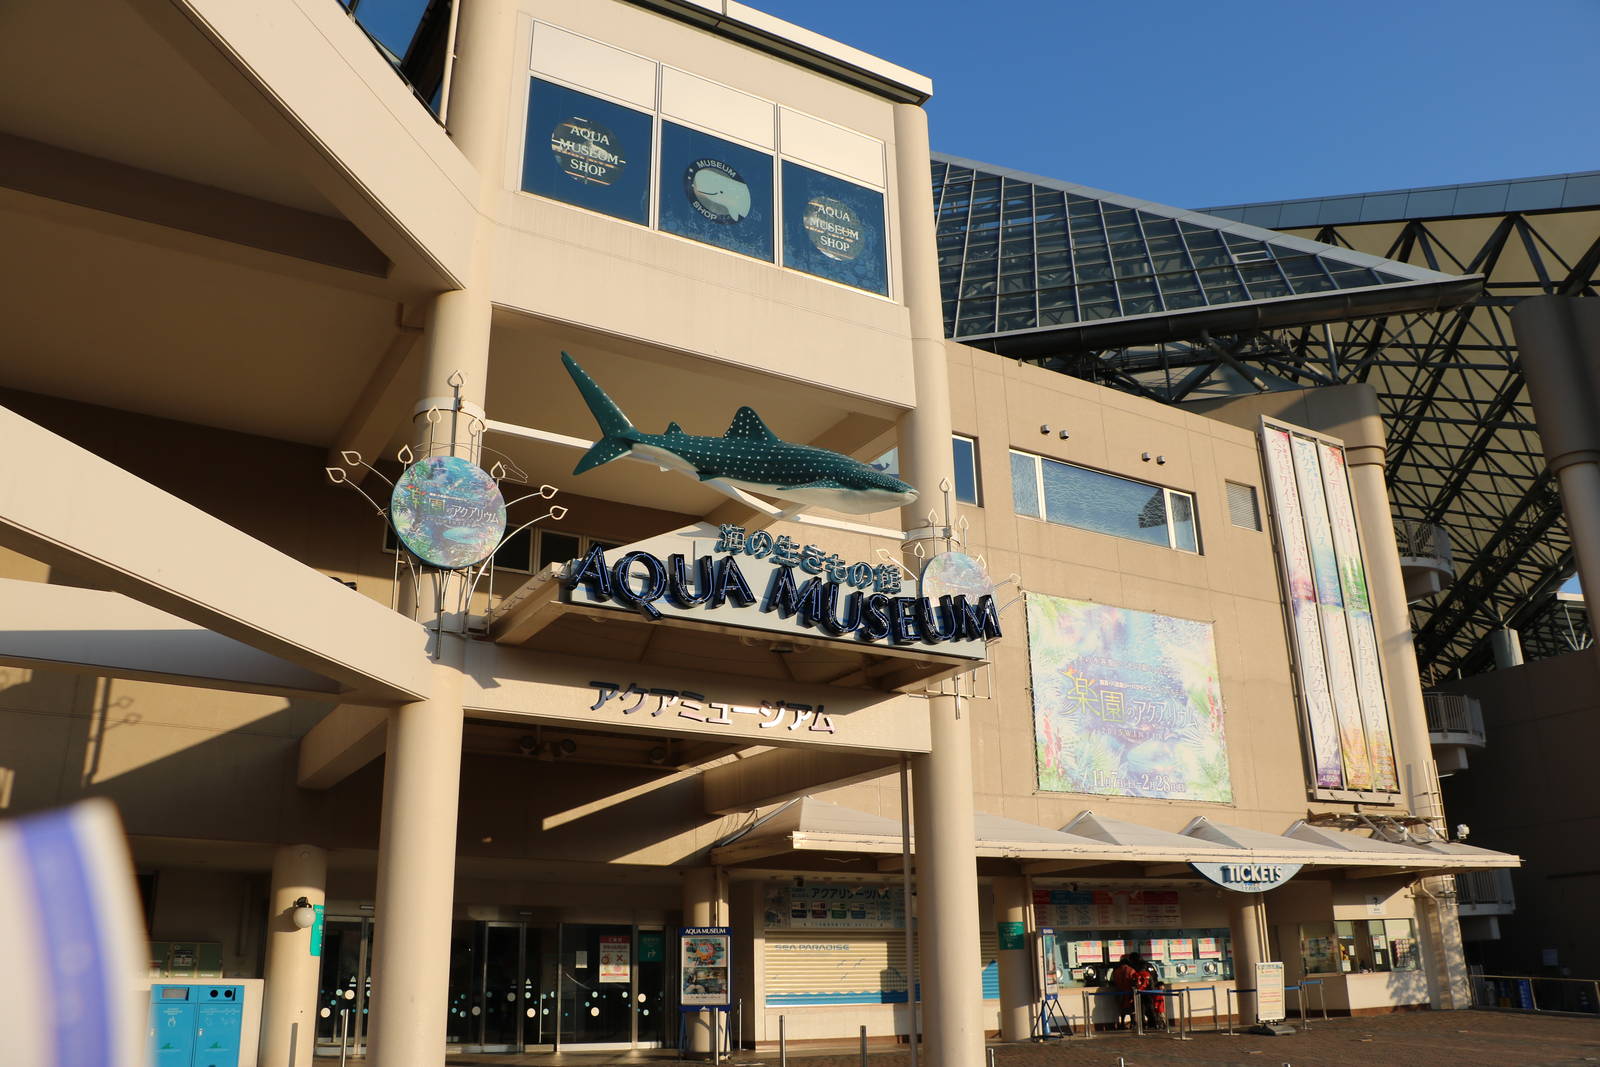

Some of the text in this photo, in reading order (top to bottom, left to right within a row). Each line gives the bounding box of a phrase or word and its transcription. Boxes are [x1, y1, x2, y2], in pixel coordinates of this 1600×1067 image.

[570, 126, 610, 146] AQUA
[559, 138, 619, 165] MUSEUM
[570, 158, 606, 176] SHOP
[696, 159, 737, 178] MUSEUM
[692, 200, 718, 220] SHOP
[817, 205, 850, 222] AQUA
[809, 216, 859, 241] MUSEUM
[820, 235, 850, 252] SHOP
[714, 523, 904, 595] 海の生きもの館
[569, 543, 1003, 646] AQUA MUSEUM
[589, 680, 838, 736] アクアミュージアム
[1221, 864, 1282, 883] TICKETS
[684, 928, 727, 936] AQUA MUSEUM
